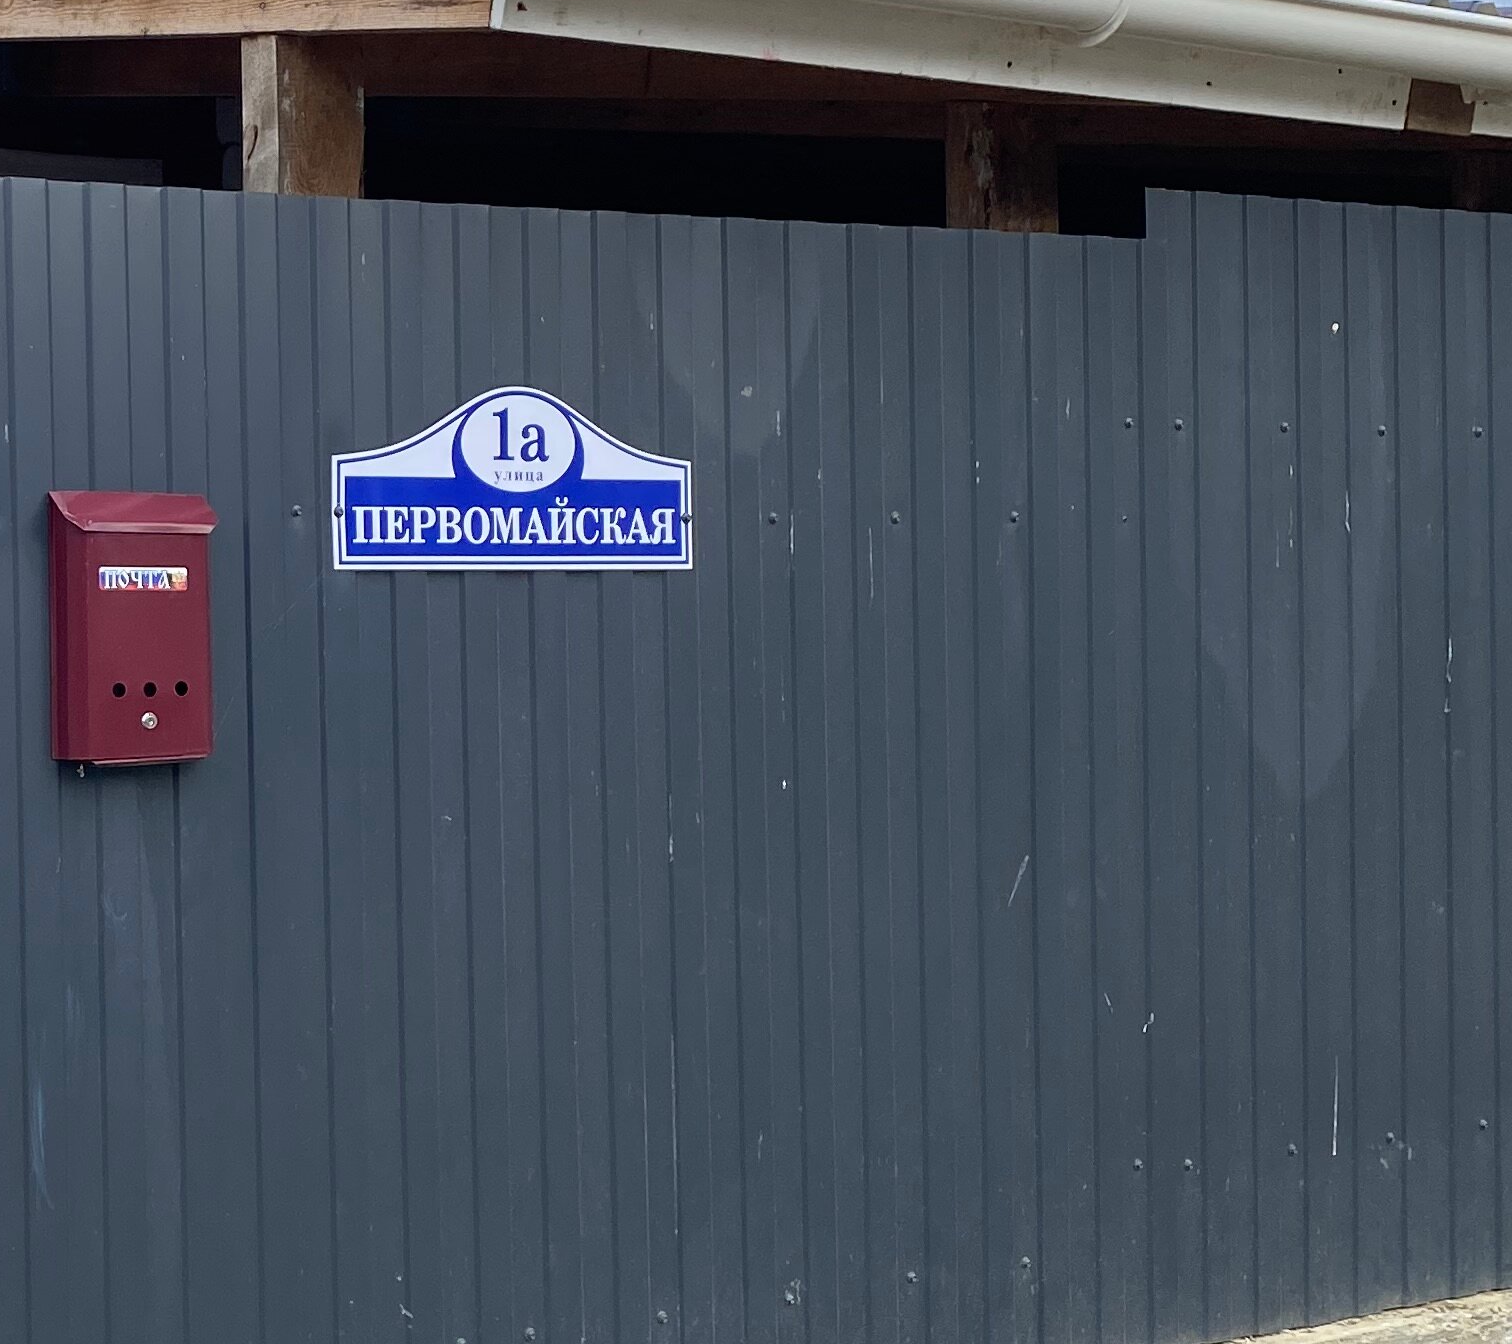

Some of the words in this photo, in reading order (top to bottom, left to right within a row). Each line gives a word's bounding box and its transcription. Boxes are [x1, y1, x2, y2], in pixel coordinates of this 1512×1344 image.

[492, 407, 550, 462] 1а
[493, 468, 544, 484] улица
[352, 496, 676, 545] ПЕРВОМАЙСКАЯ
[104, 569, 171, 589] ПОЧТА
